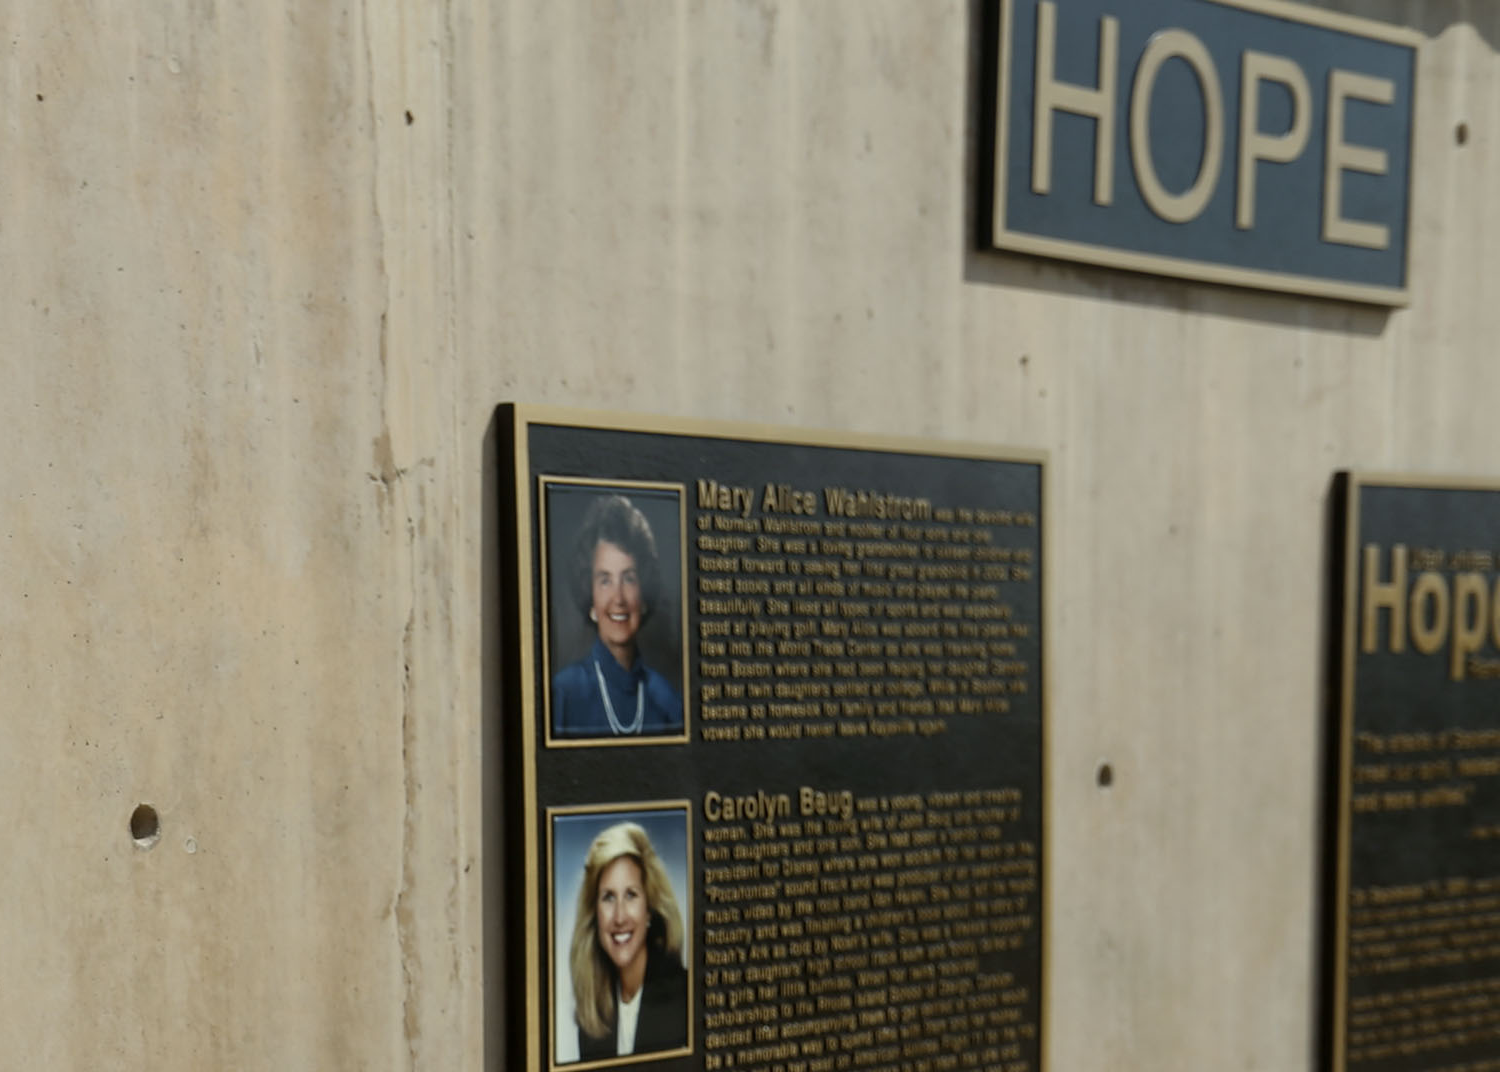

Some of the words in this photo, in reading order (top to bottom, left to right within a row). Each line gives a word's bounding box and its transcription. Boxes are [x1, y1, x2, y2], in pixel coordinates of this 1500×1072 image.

[1031, 0, 1396, 250] HOPE
[697, 480, 753, 517] Mary
[763, 484, 816, 516] Alice
[825, 487, 932, 521] Wahlstrom
[698, 517, 711, 530] of
[714, 516, 759, 533] Norman
[757, 538, 780, 553] She
[742, 558, 785, 573] forward
[767, 599, 789, 615] She
[1361, 543, 1500, 681] Hop
[700, 620, 729, 637] good
[750, 620, 790, 638] playing
[755, 642, 773, 654] the
[701, 662, 727, 678] from
[705, 790, 790, 822] Carolyn
[799, 787, 853, 819] Beug
